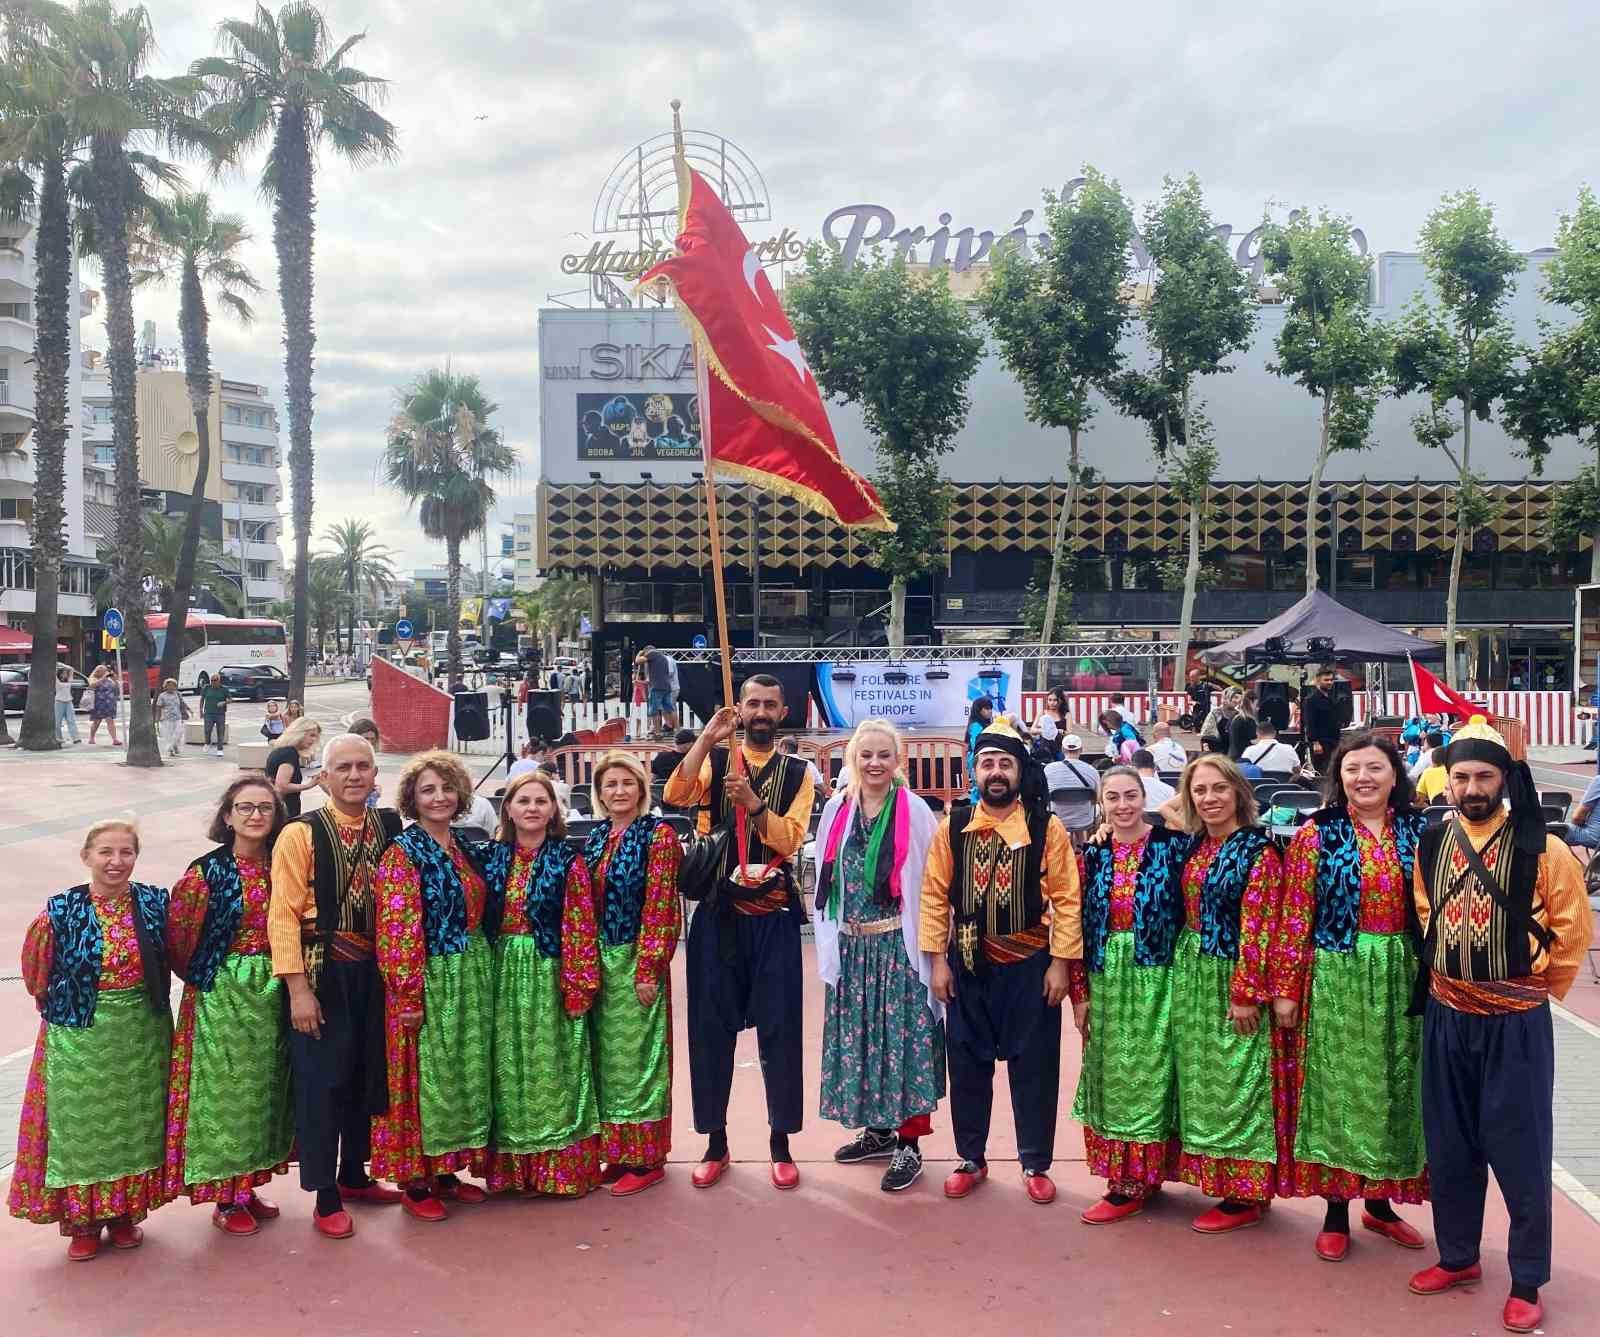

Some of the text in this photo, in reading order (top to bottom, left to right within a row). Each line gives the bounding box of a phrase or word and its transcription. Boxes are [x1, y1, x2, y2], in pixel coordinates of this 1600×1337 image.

[587, 448, 614, 456] BOOBA
[631, 448, 645, 456] JUL
[656, 448, 701, 456] VEGEDREAM
[855, 690, 932, 700] FESTIVALS IN
[870, 705, 917, 715] EUROPE
